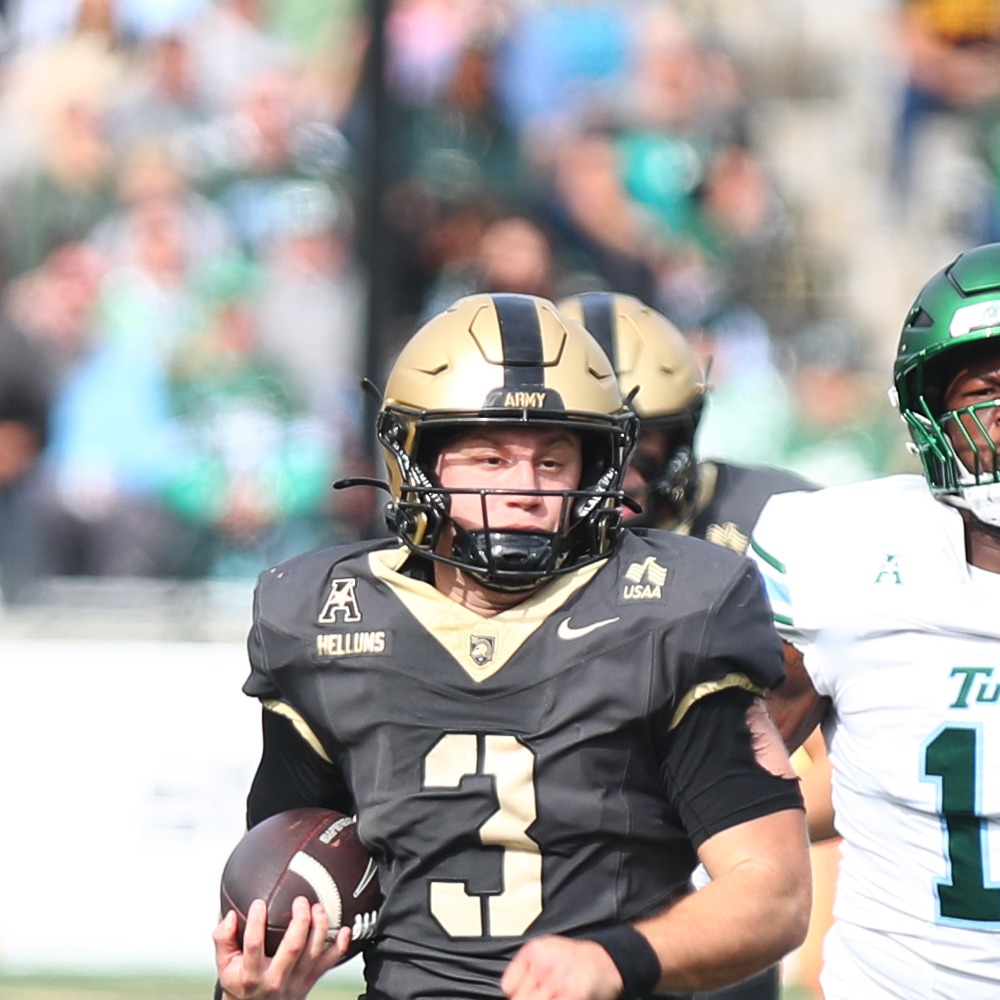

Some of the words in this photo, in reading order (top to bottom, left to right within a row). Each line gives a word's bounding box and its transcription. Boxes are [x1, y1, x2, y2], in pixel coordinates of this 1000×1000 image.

[504, 391, 547, 408] ARMY
[623, 584, 662, 599] USAA
[316, 631, 386, 656] HELLUMS
[423, 733, 544, 937] 3
